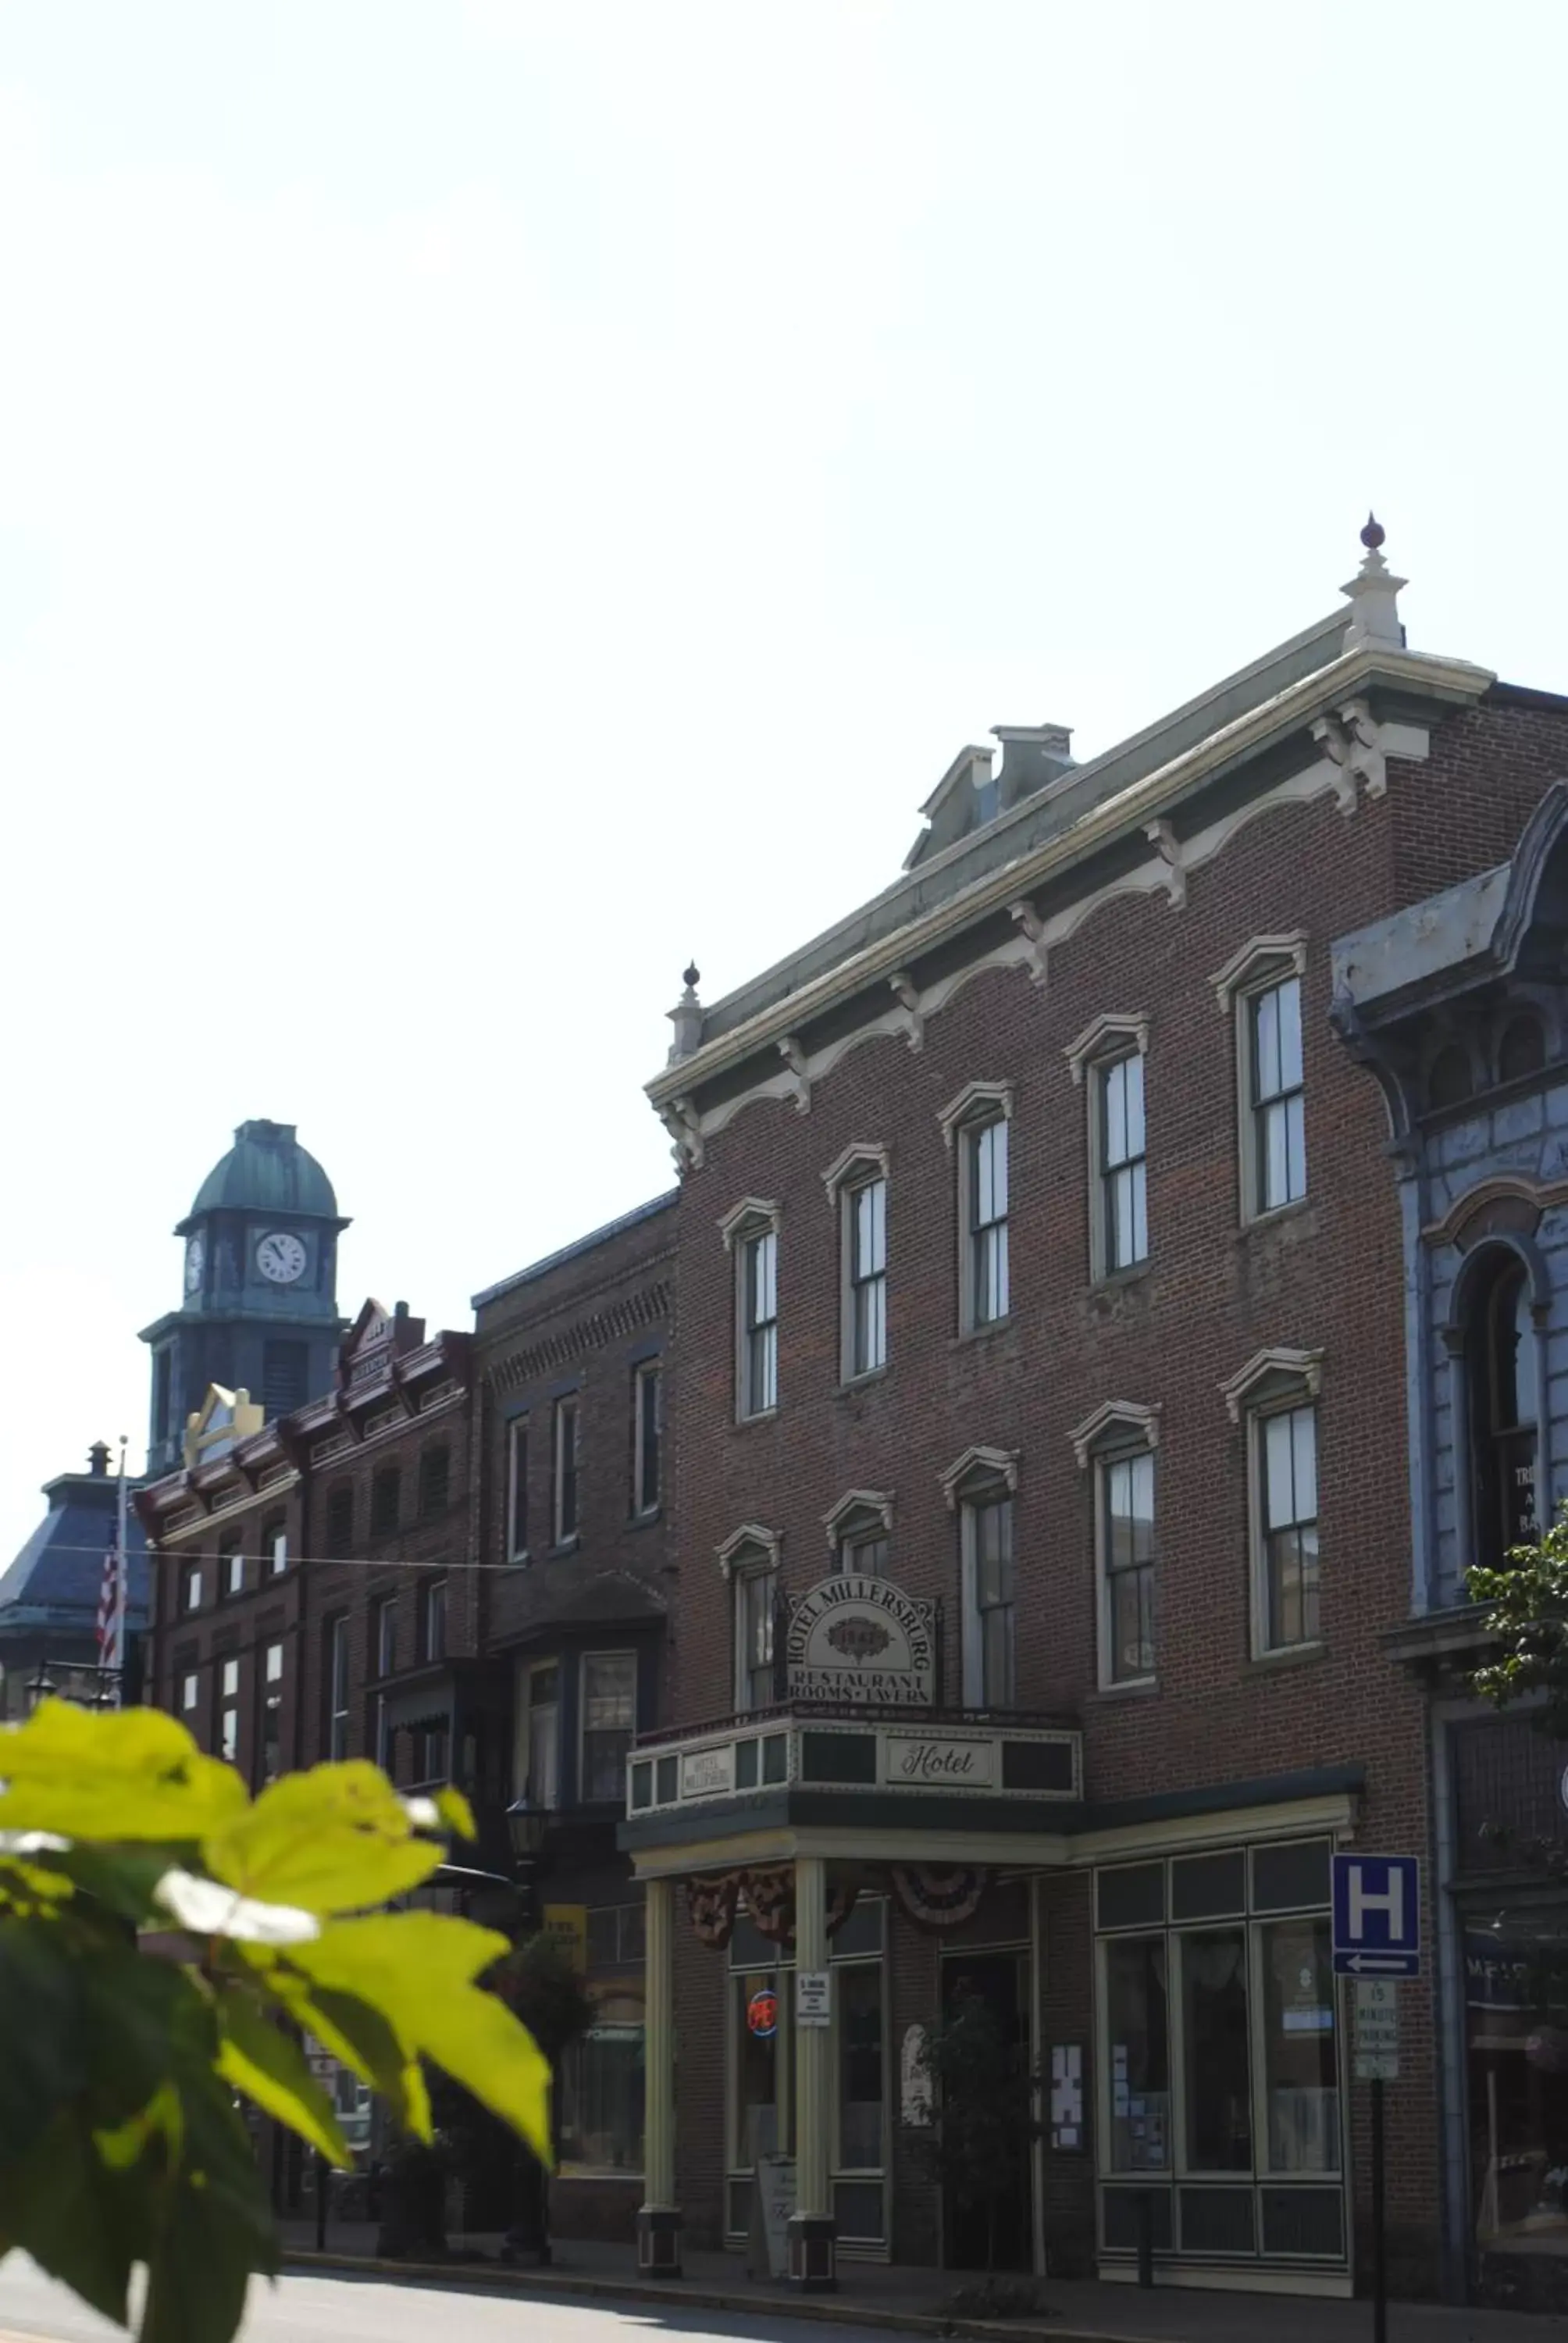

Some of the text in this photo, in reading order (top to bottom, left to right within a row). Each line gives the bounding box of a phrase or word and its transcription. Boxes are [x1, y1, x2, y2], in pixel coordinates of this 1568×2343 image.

[788, 1581, 930, 1671] HOTEL MILLERSBURG
[793, 1671, 924, 1689] RESTAURANT
[789, 1685, 928, 1703] ROOMS TAVERN
[900, 1746, 975, 1779] Hotel
[1348, 1865, 1404, 1941] H
[1371, 1988, 1385, 2002] 15
